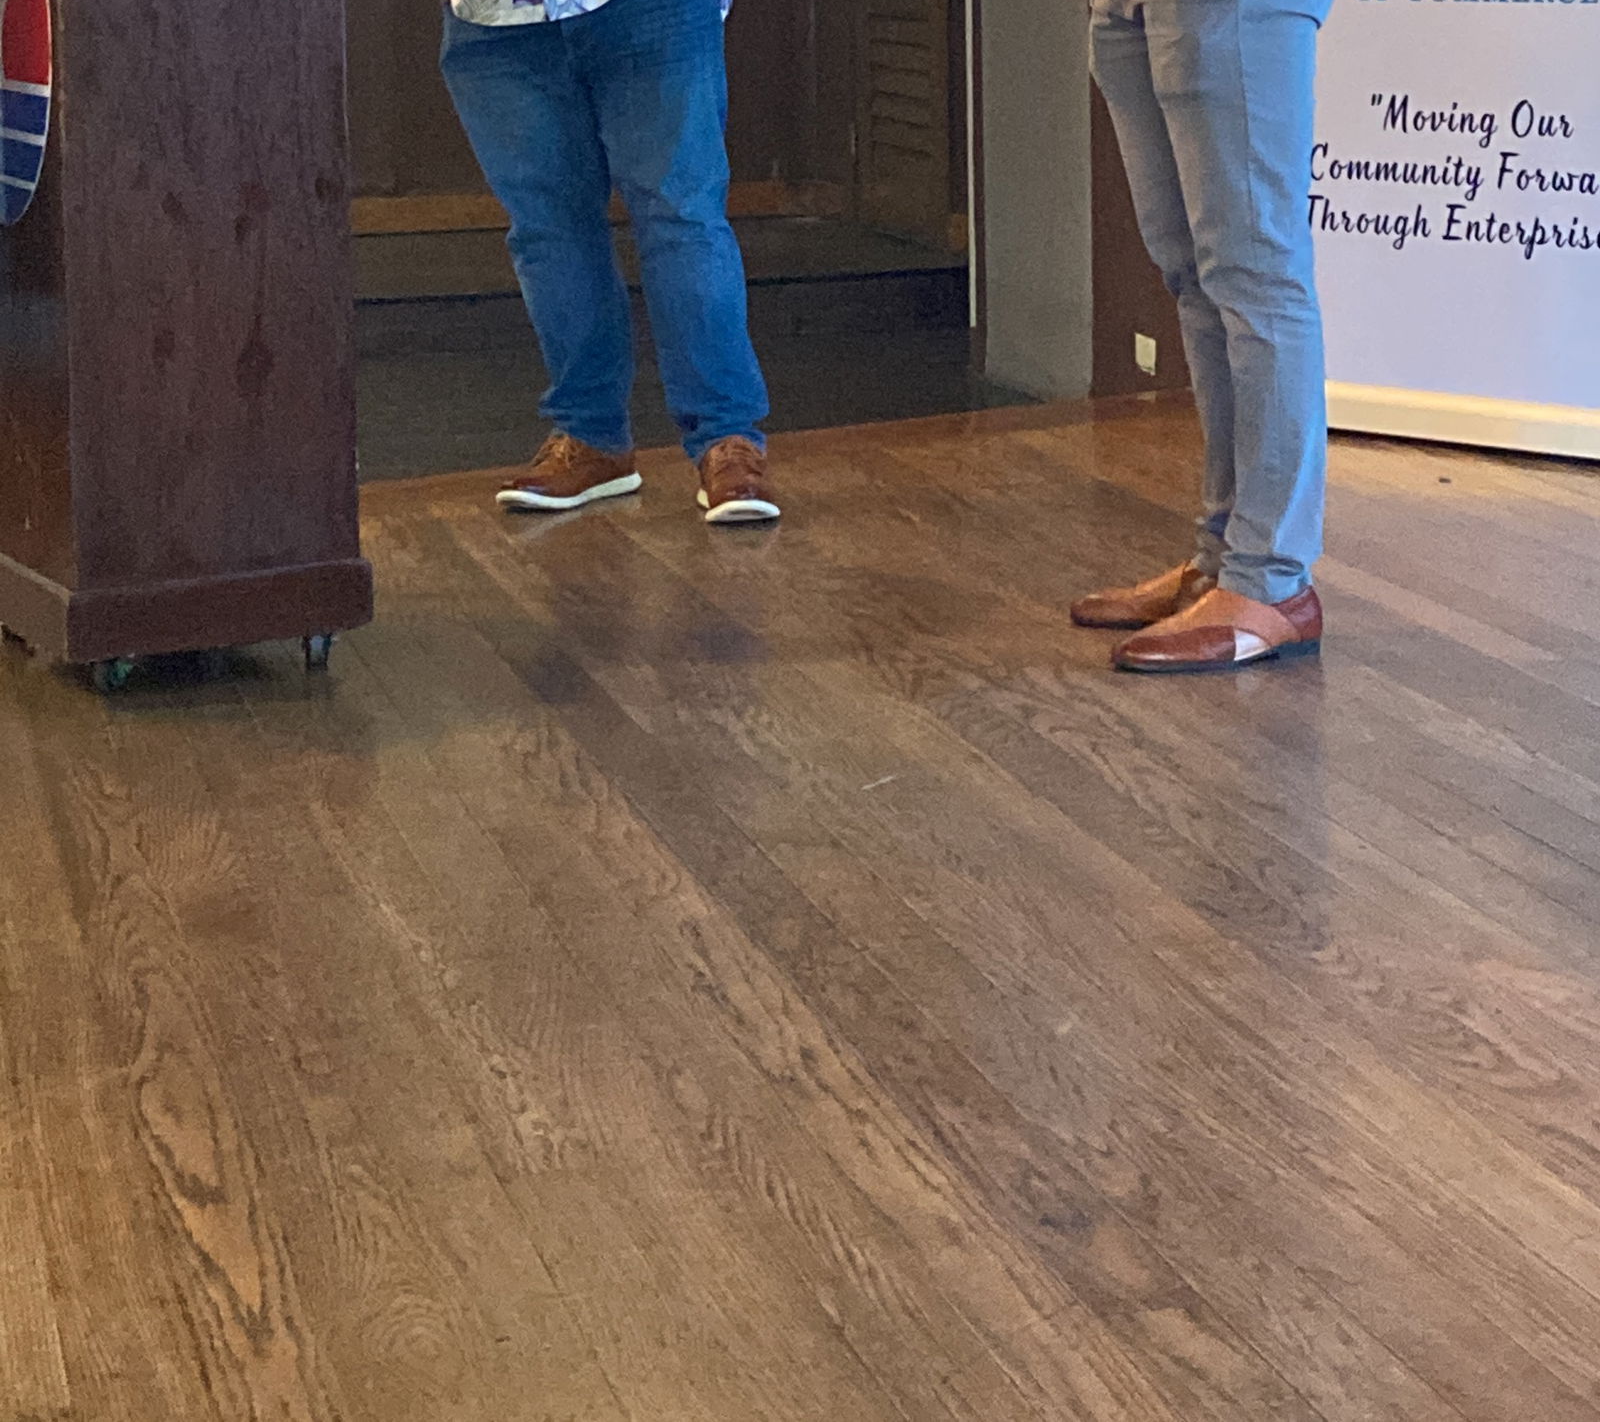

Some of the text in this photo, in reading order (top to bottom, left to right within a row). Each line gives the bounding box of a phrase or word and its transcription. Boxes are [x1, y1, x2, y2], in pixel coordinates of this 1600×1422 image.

[1370, 93, 1574, 149] "Moving Our
[1310, 142, 1484, 201] Community
[1307, 194, 1600, 260] Through Enterpris
